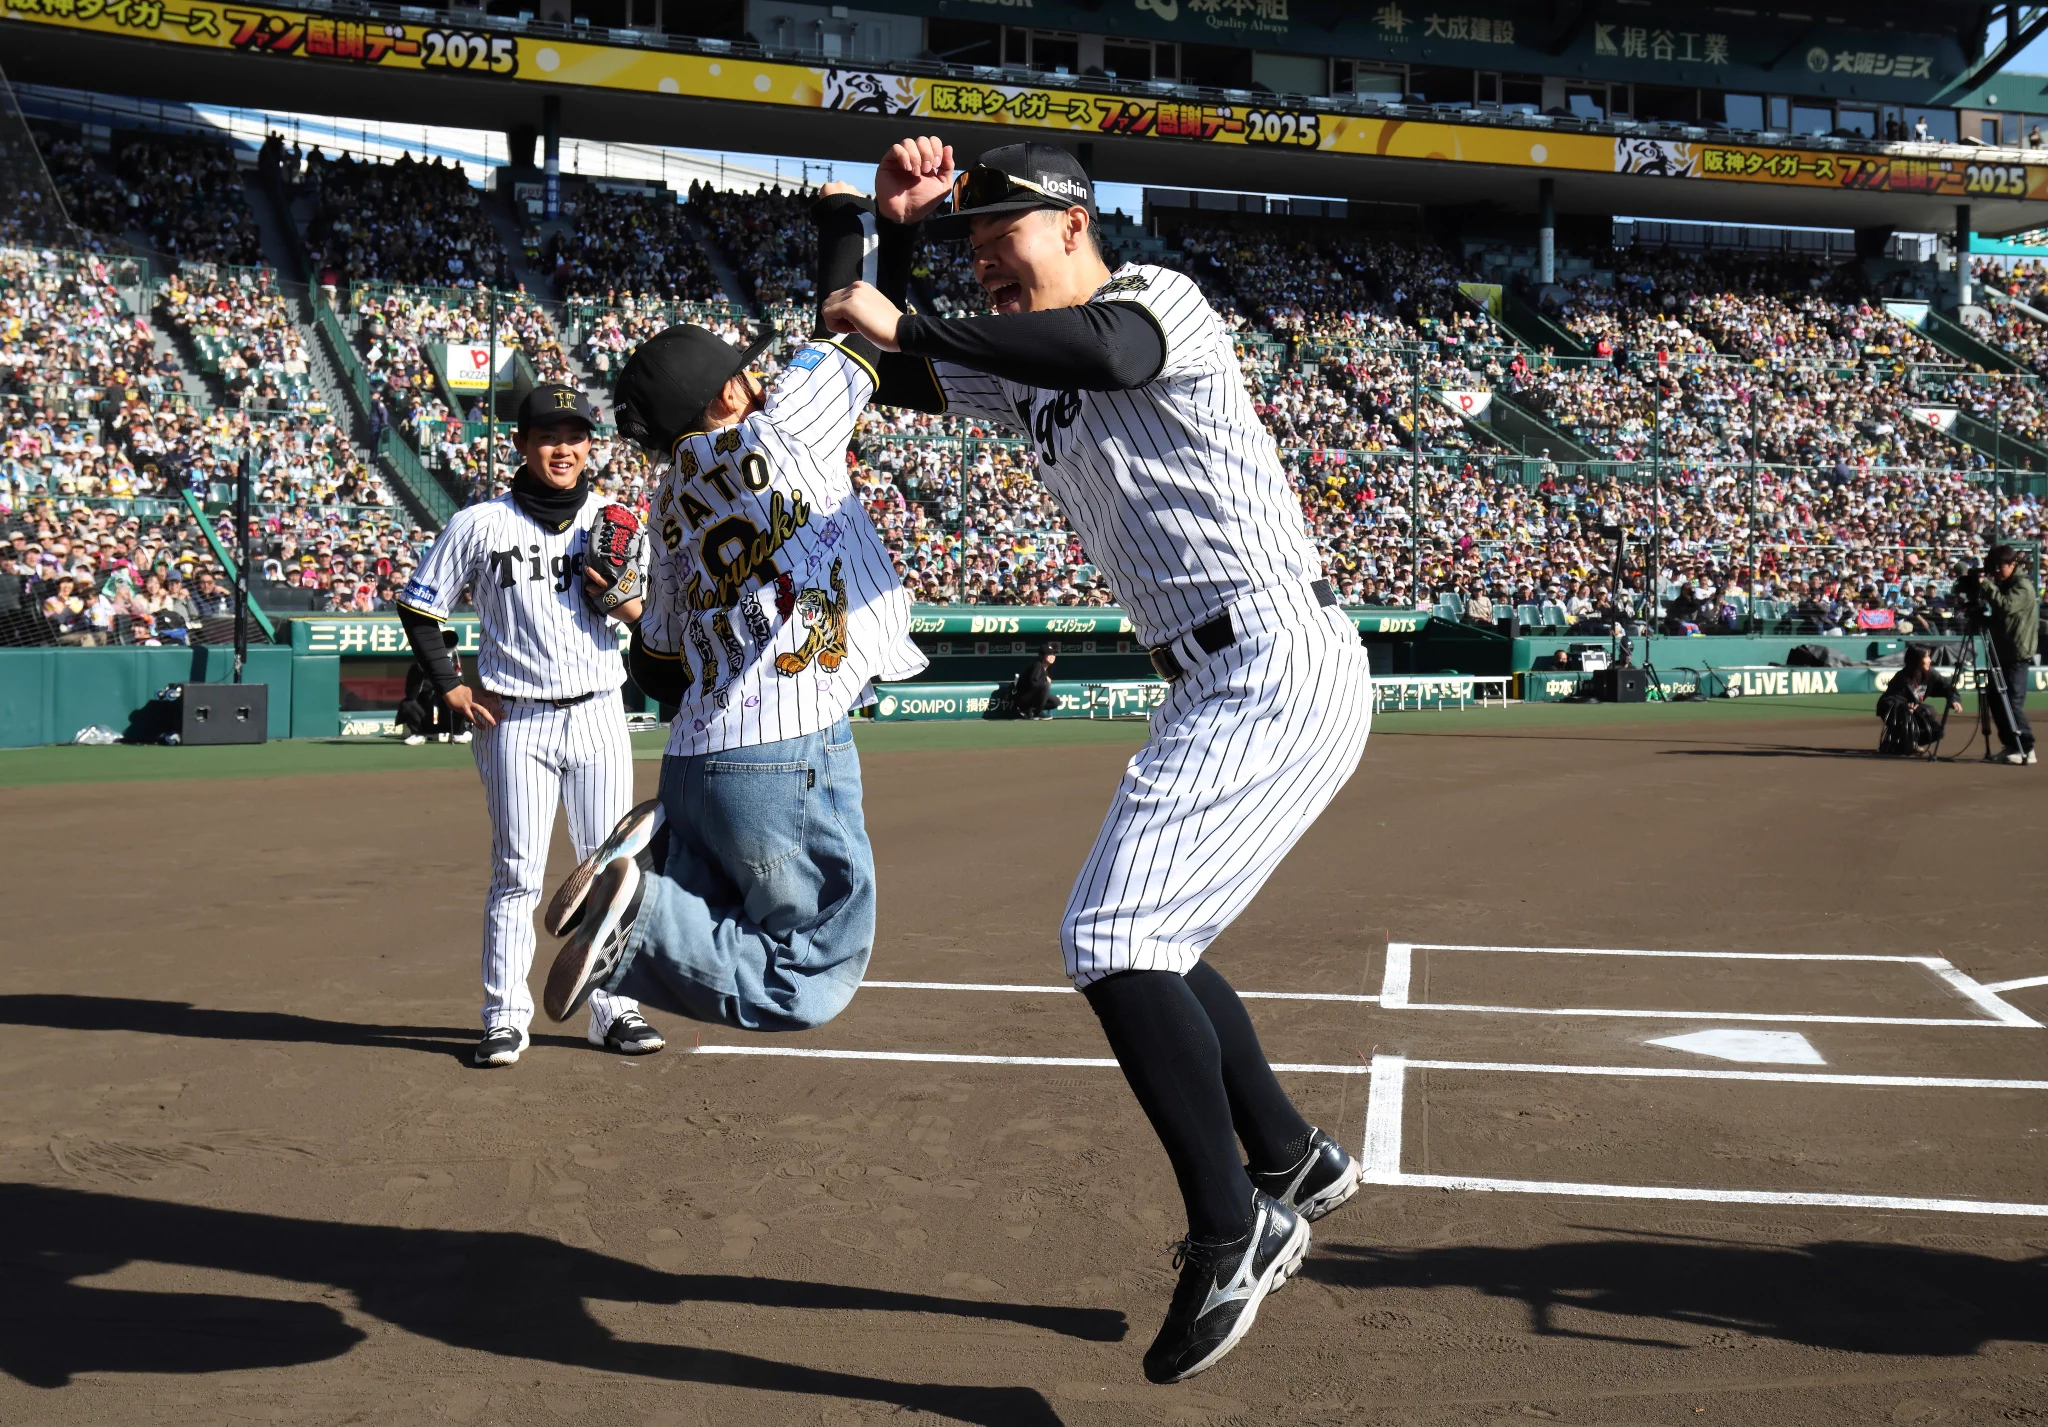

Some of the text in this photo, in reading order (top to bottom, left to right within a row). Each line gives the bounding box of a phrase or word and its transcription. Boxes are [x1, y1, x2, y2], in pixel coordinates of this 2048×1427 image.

[1206, 15, 1289, 36] Quality Always
[1423, 13, 1515, 45] 大成建設
[224, 9, 420, 61] ファン感謝デー
[426, 32, 514, 74] 2025
[1621, 26, 1729, 66] 梶谷工業
[1831, 50, 1935, 80] 大阪シミズ
[933, 85, 1319, 147] 阪神タイガース ファン感謝デー 2025
[1703, 149, 2027, 196] 阪神タイガース ファン感謝デー 2025
[662, 451, 770, 552] SATO
[491, 544, 585, 593] Tige
[406, 582, 435, 602] Joshin
[910, 618, 945, 632] イジェック
[1055, 618, 1096, 633] エイジェック
[1793, 670, 1838, 694] MAX
[901, 699, 956, 714] SOMPO
[966, 697, 1014, 713] 損保ジャ
